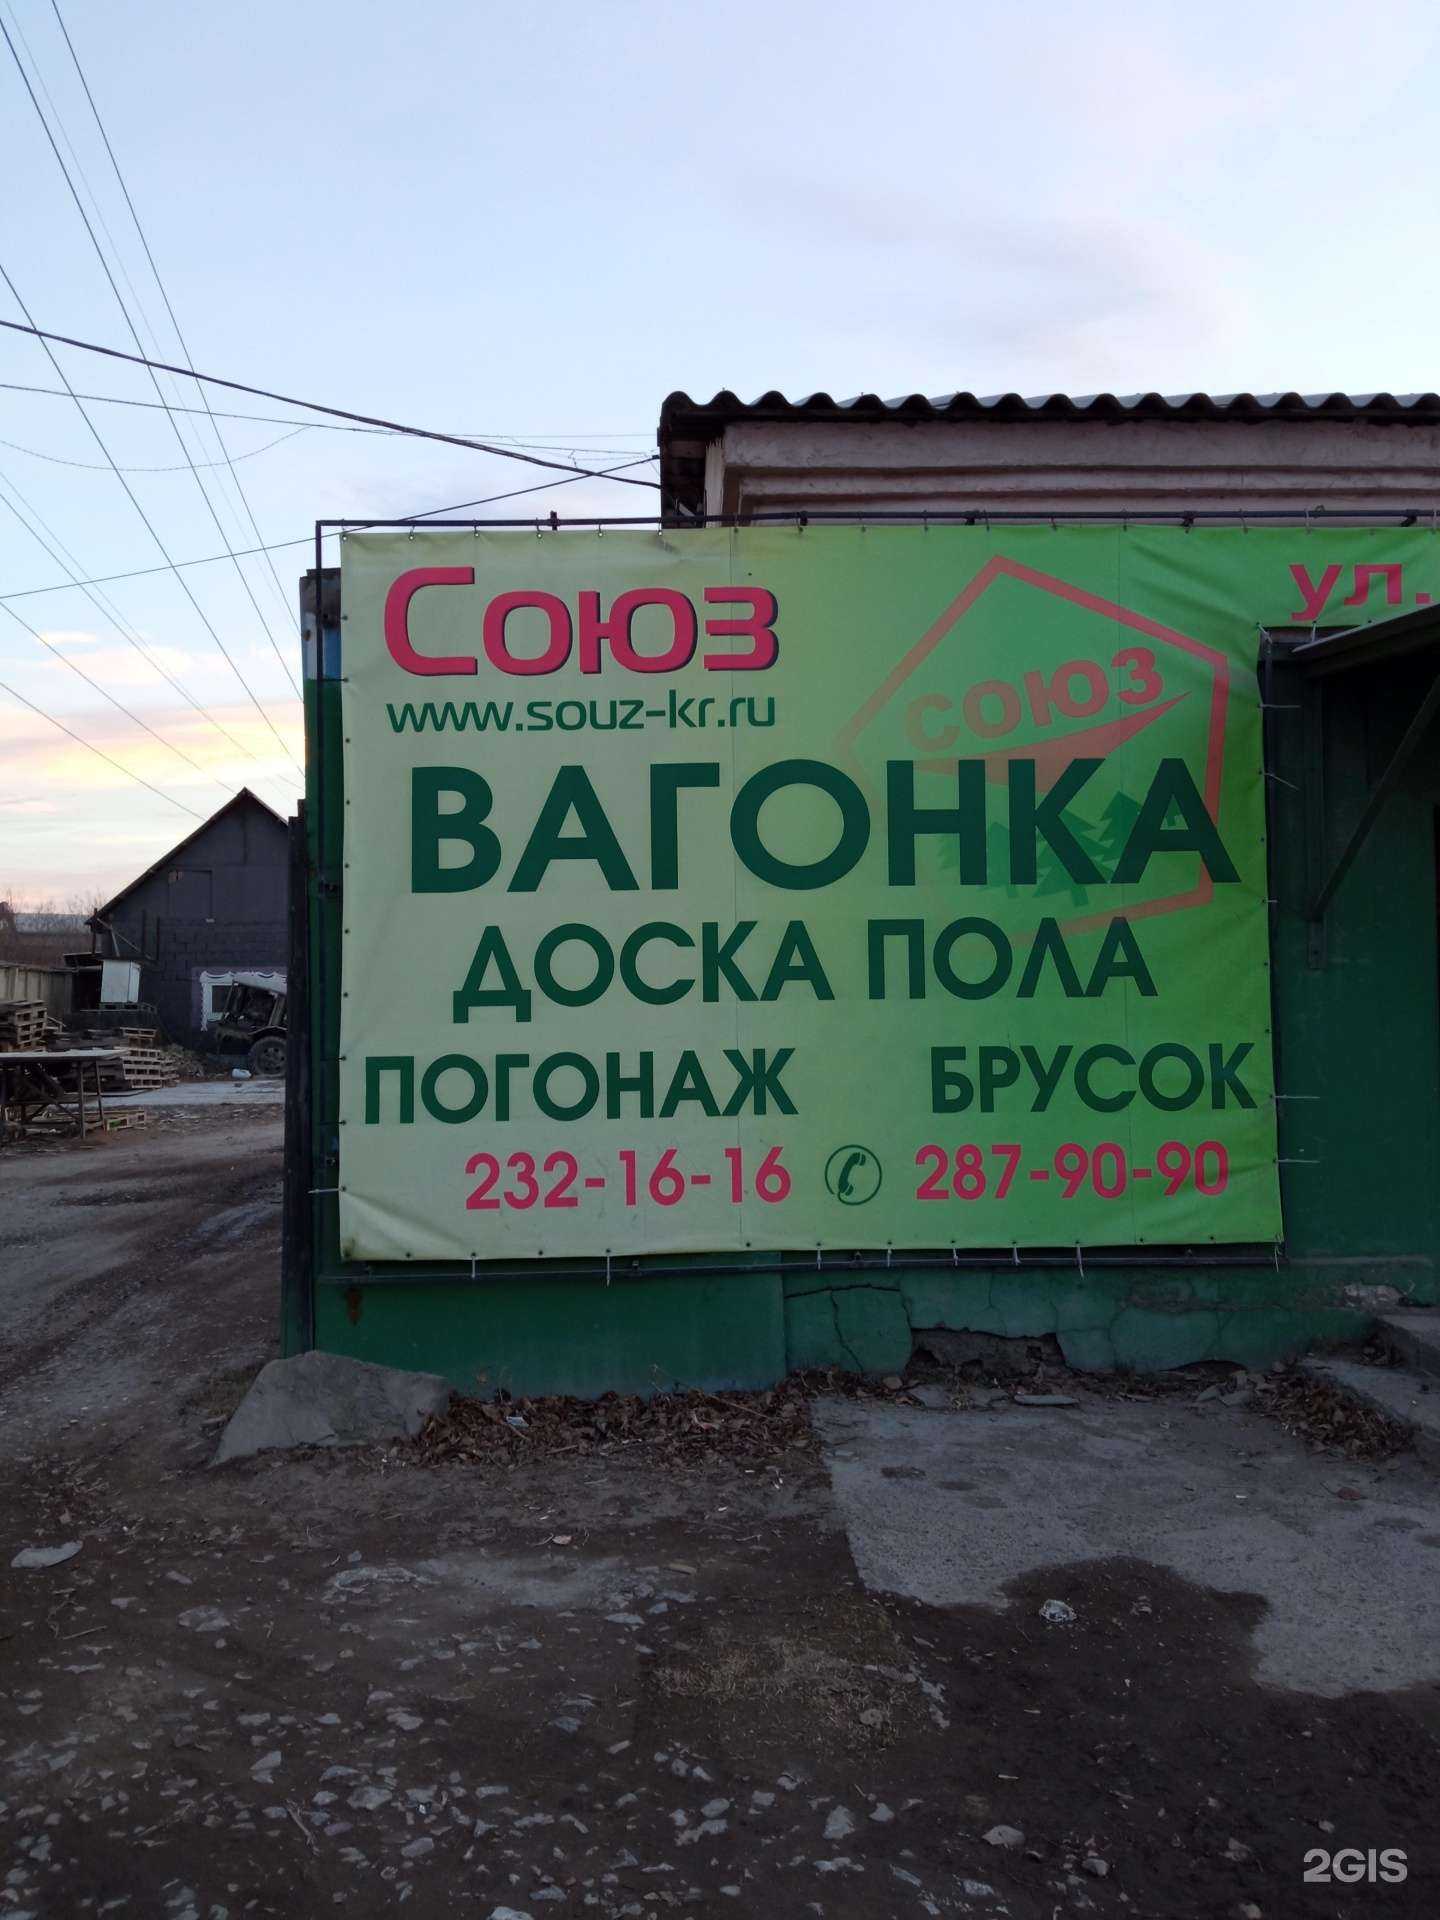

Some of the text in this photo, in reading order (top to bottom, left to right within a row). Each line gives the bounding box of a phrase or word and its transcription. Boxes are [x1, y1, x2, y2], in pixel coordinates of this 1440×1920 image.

[1289, 564, 1431, 621] ул.
[386, 689, 776, 733] www.souz-kr.ru
[411, 757, 1242, 894] ВАГОНКА
[452, 916, 1158, 1023] ДОСКА ПОЛА
[364, 1042, 1257, 1125] ПОГОНАЖ БРУСОК
[464, 1140, 1229, 1211] 232-16-16 287-90-90
